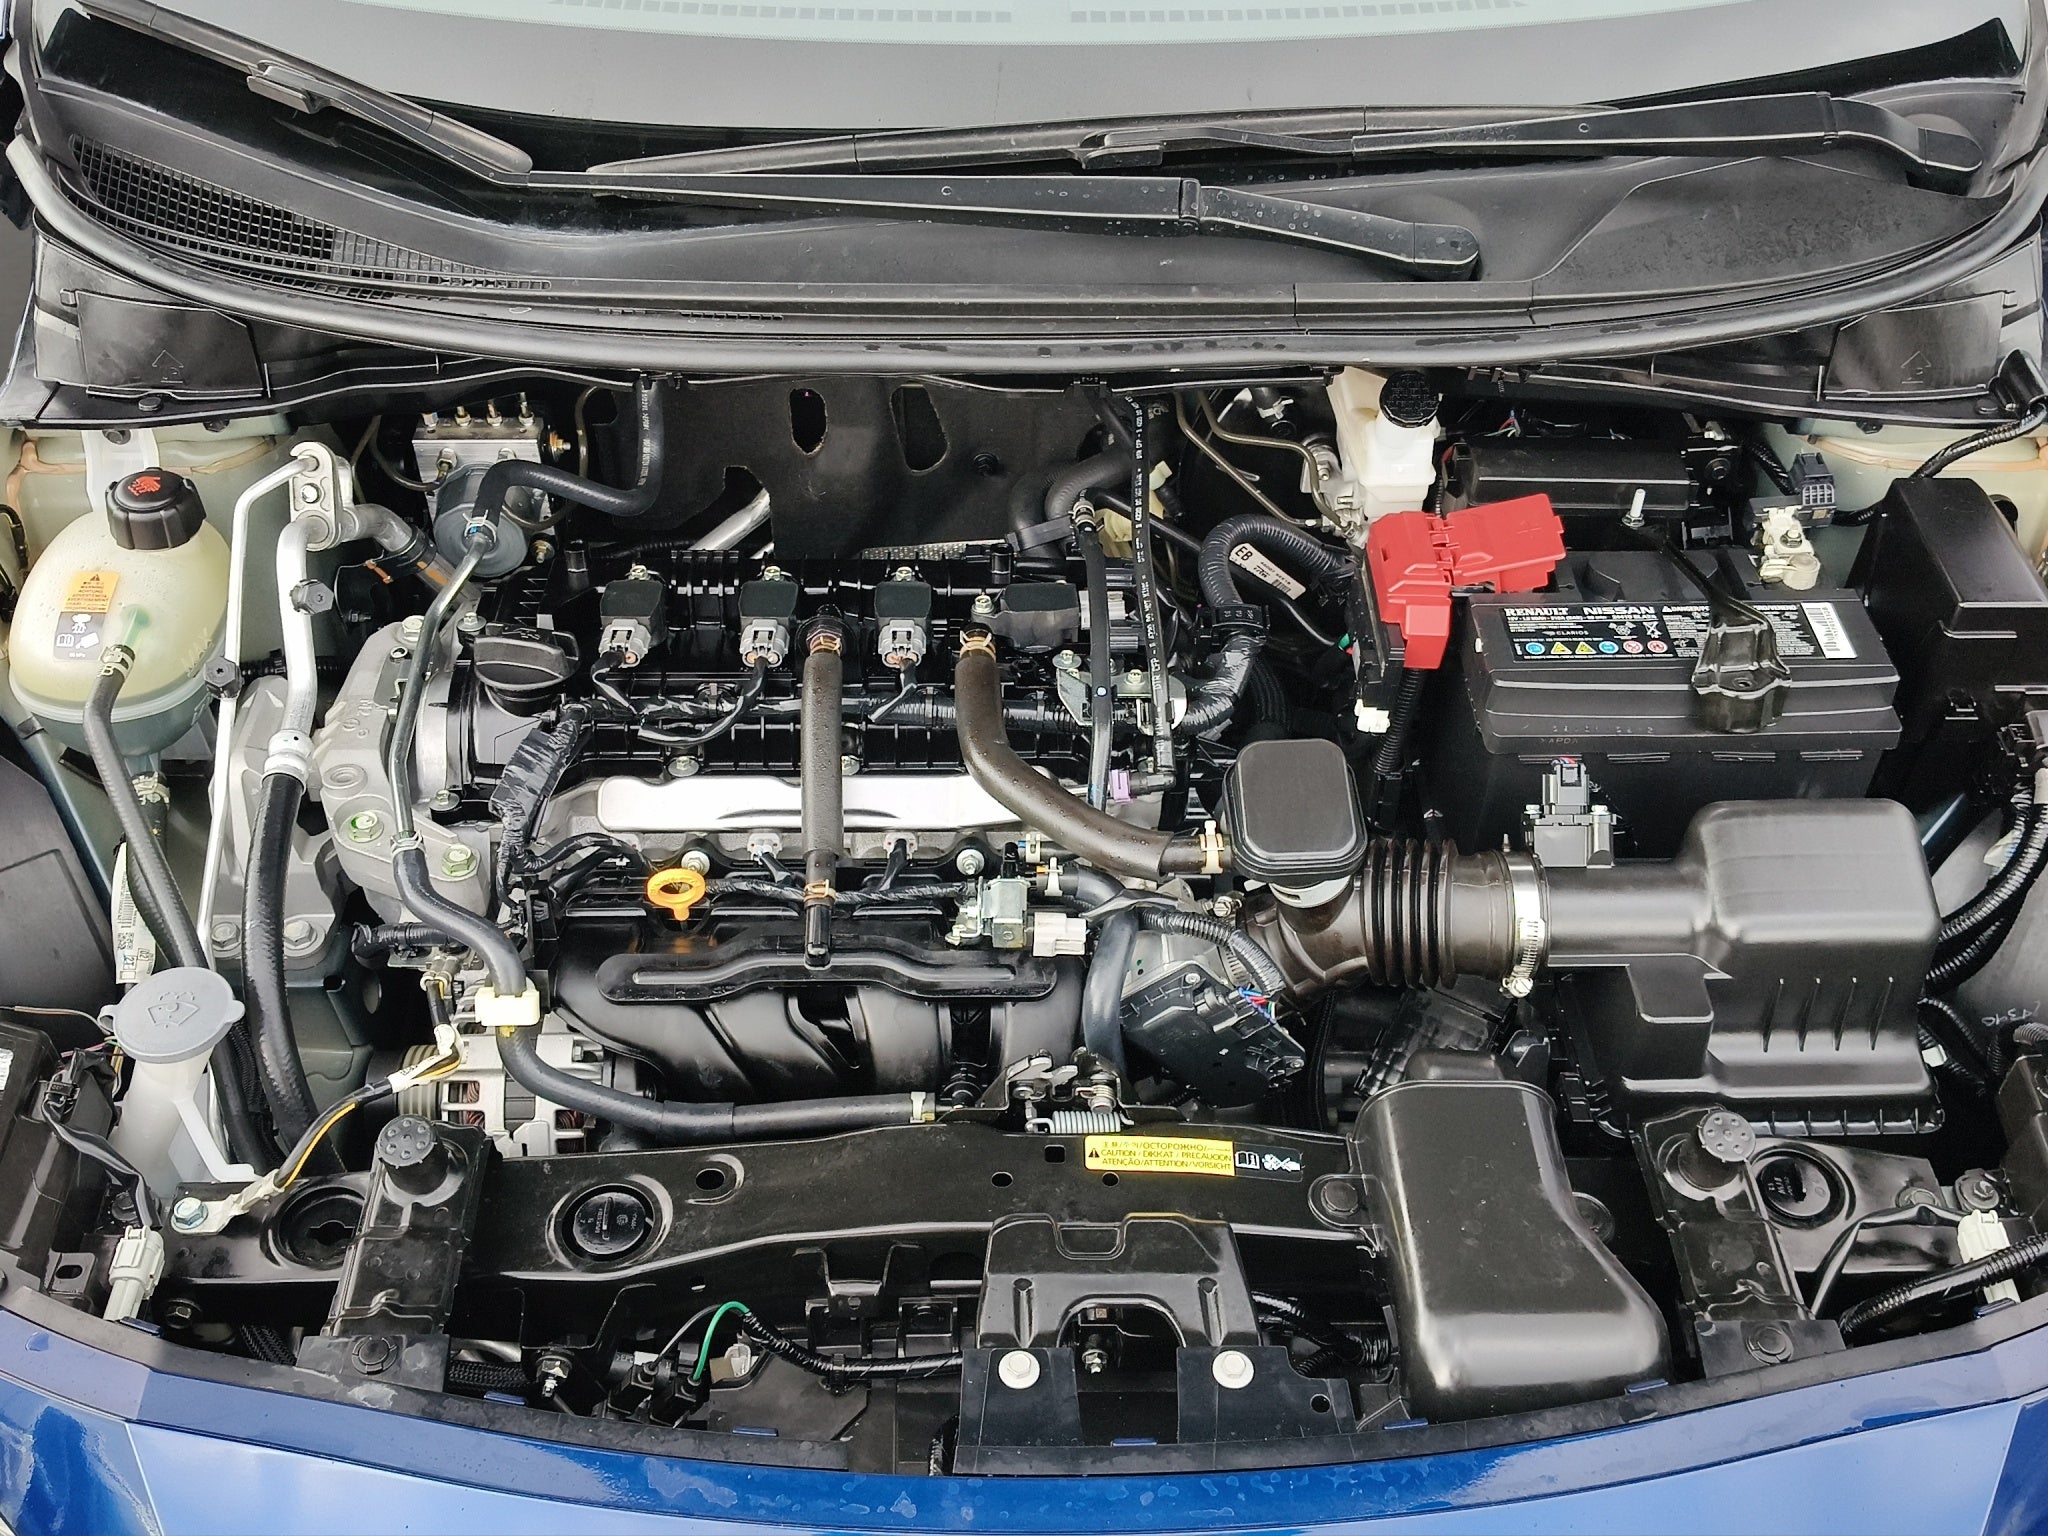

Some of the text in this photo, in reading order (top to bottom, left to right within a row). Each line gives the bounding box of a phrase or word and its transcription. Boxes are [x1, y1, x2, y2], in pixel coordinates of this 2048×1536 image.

[1235, 545, 1253, 561] EB
[1504, 606, 1656, 616] RENAULT NISSAN
[1101, 1149, 1136, 1157] CAUTION
